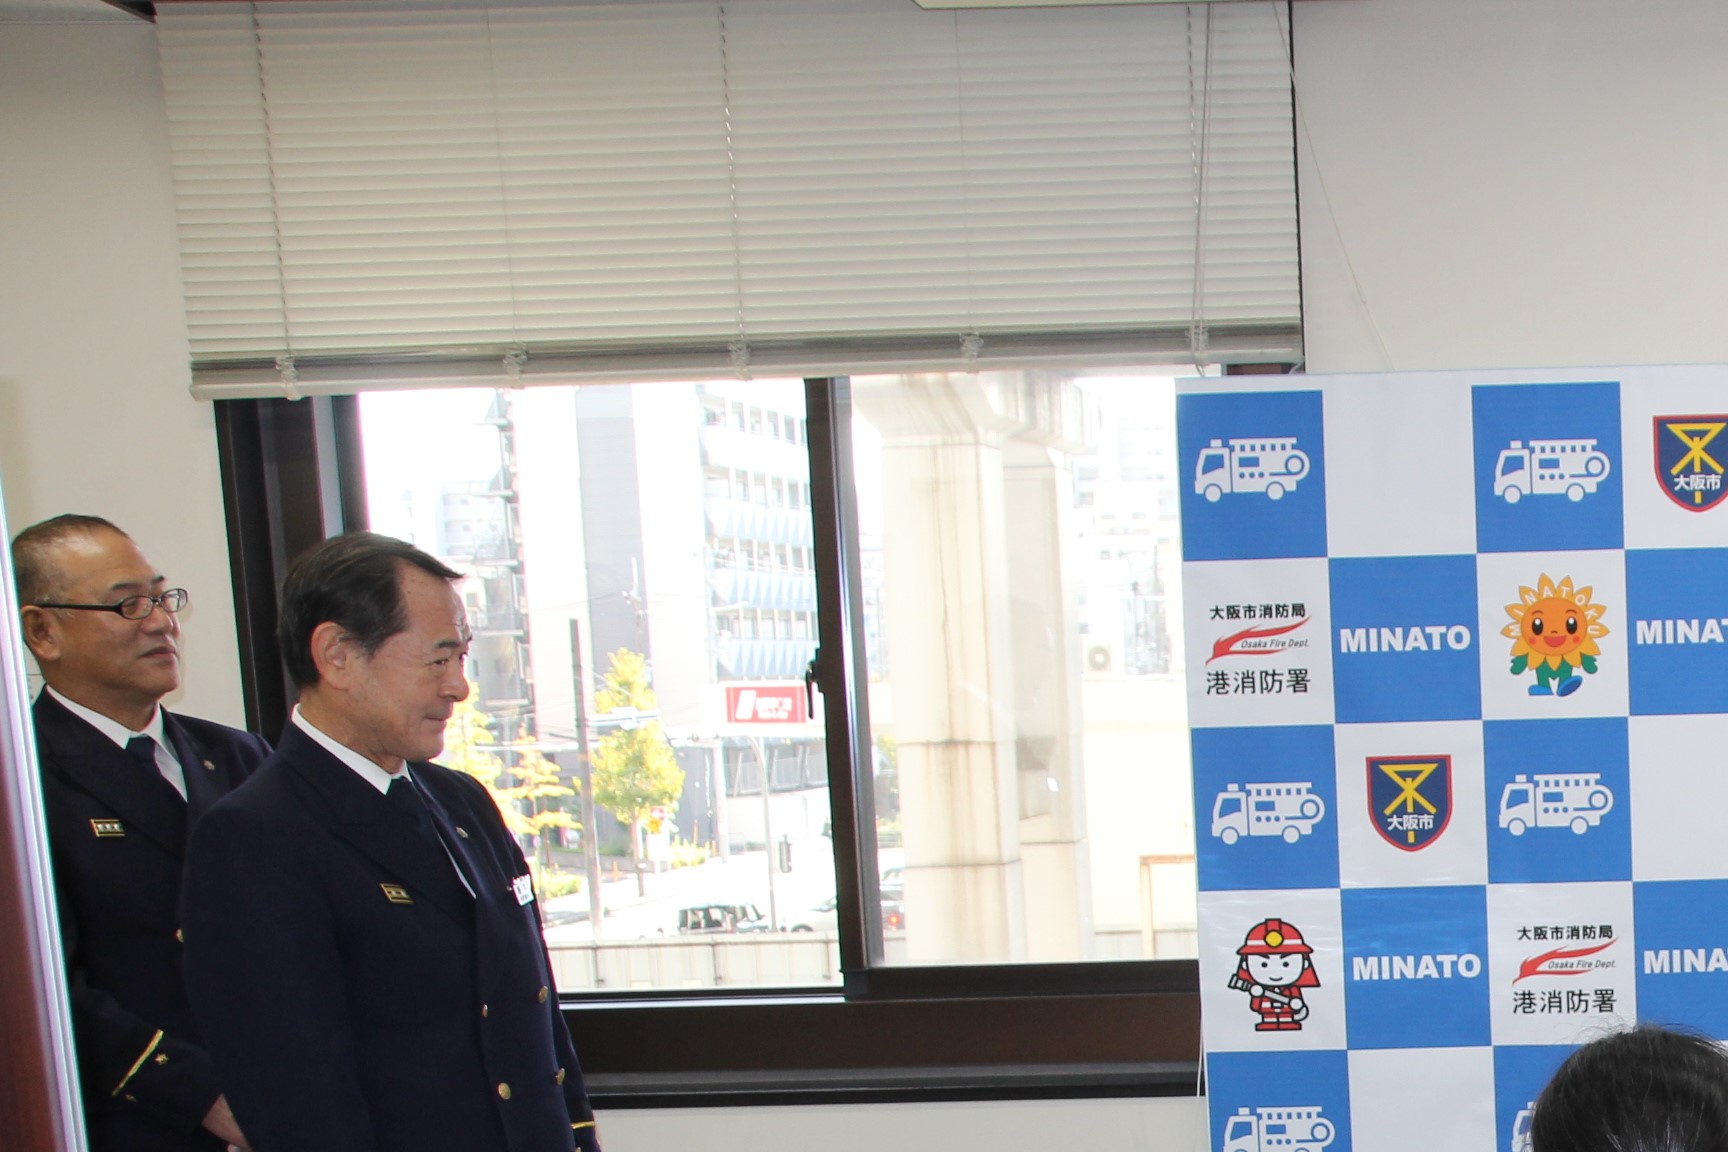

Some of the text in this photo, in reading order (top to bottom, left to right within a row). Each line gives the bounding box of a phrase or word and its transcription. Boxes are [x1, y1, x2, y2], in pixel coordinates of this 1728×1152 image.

[1674, 473, 1722, 491] 大阪市
[1209, 603, 1306, 620] 大阪市消防局
[1240, 639, 1268, 650] Osaka
[1269, 638, 1287, 649] Fire
[1339, 625, 1471, 653] MINATO
[1205, 668, 1311, 696] 港消防署
[1387, 813, 1434, 831] 大阪市
[1517, 924, 1614, 942] 大阪市消防局
[1352, 953, 1482, 981] MINATO
[1548, 959, 1574, 970] Osaka
[1576, 959, 1593, 970] Fire
[1512, 987, 1617, 1015] 港消防署
